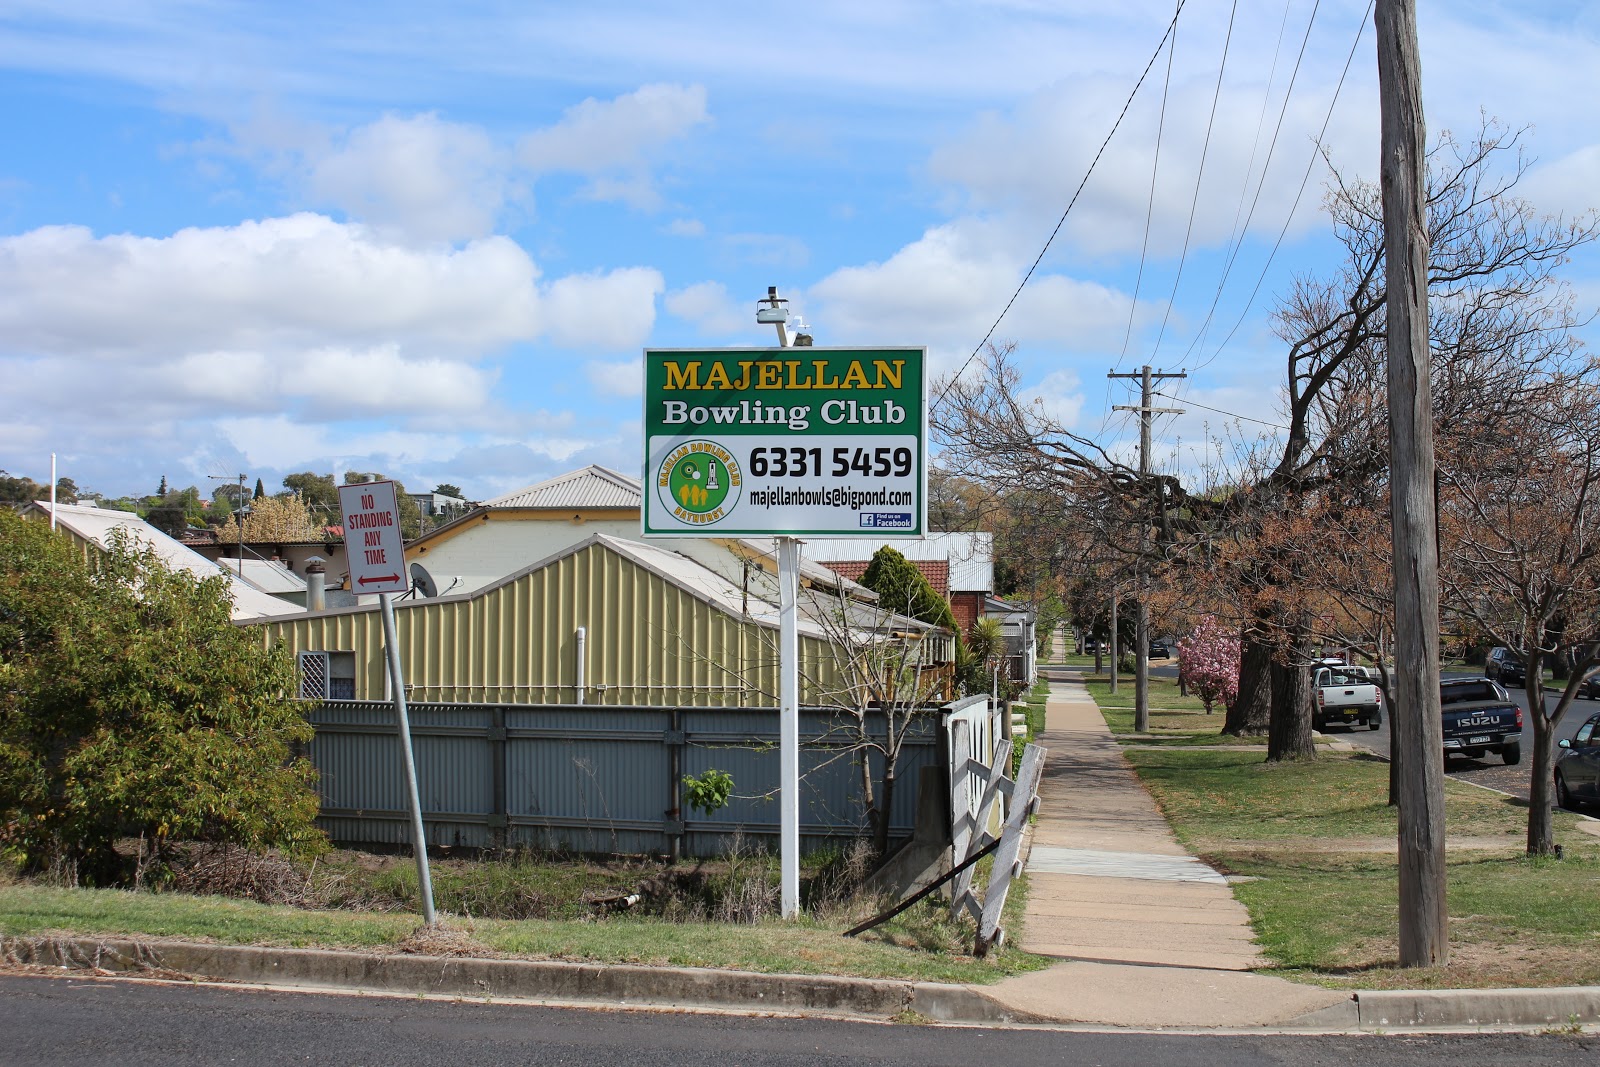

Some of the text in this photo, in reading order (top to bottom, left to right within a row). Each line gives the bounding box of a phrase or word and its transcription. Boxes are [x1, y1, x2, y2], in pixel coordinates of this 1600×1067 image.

[663, 359, 906, 391] MAJELLAN
[662, 400, 906, 430] Bowling Club
[659, 443, 740, 487] MAJELLAN BOWLING CLUB
[750, 447, 912, 477] 6331 5459
[361, 494, 375, 510] NO
[750, 486, 912, 511] majellanbowls@bigpond.com
[348, 511, 393, 530] STANDING
[674, 506, 725, 523] BATHURST
[876, 519, 911, 527] Facebook
[364, 530, 381, 547] ANY
[364, 549, 387, 565] TIME
[1456, 715, 1500, 728] ISUZU
